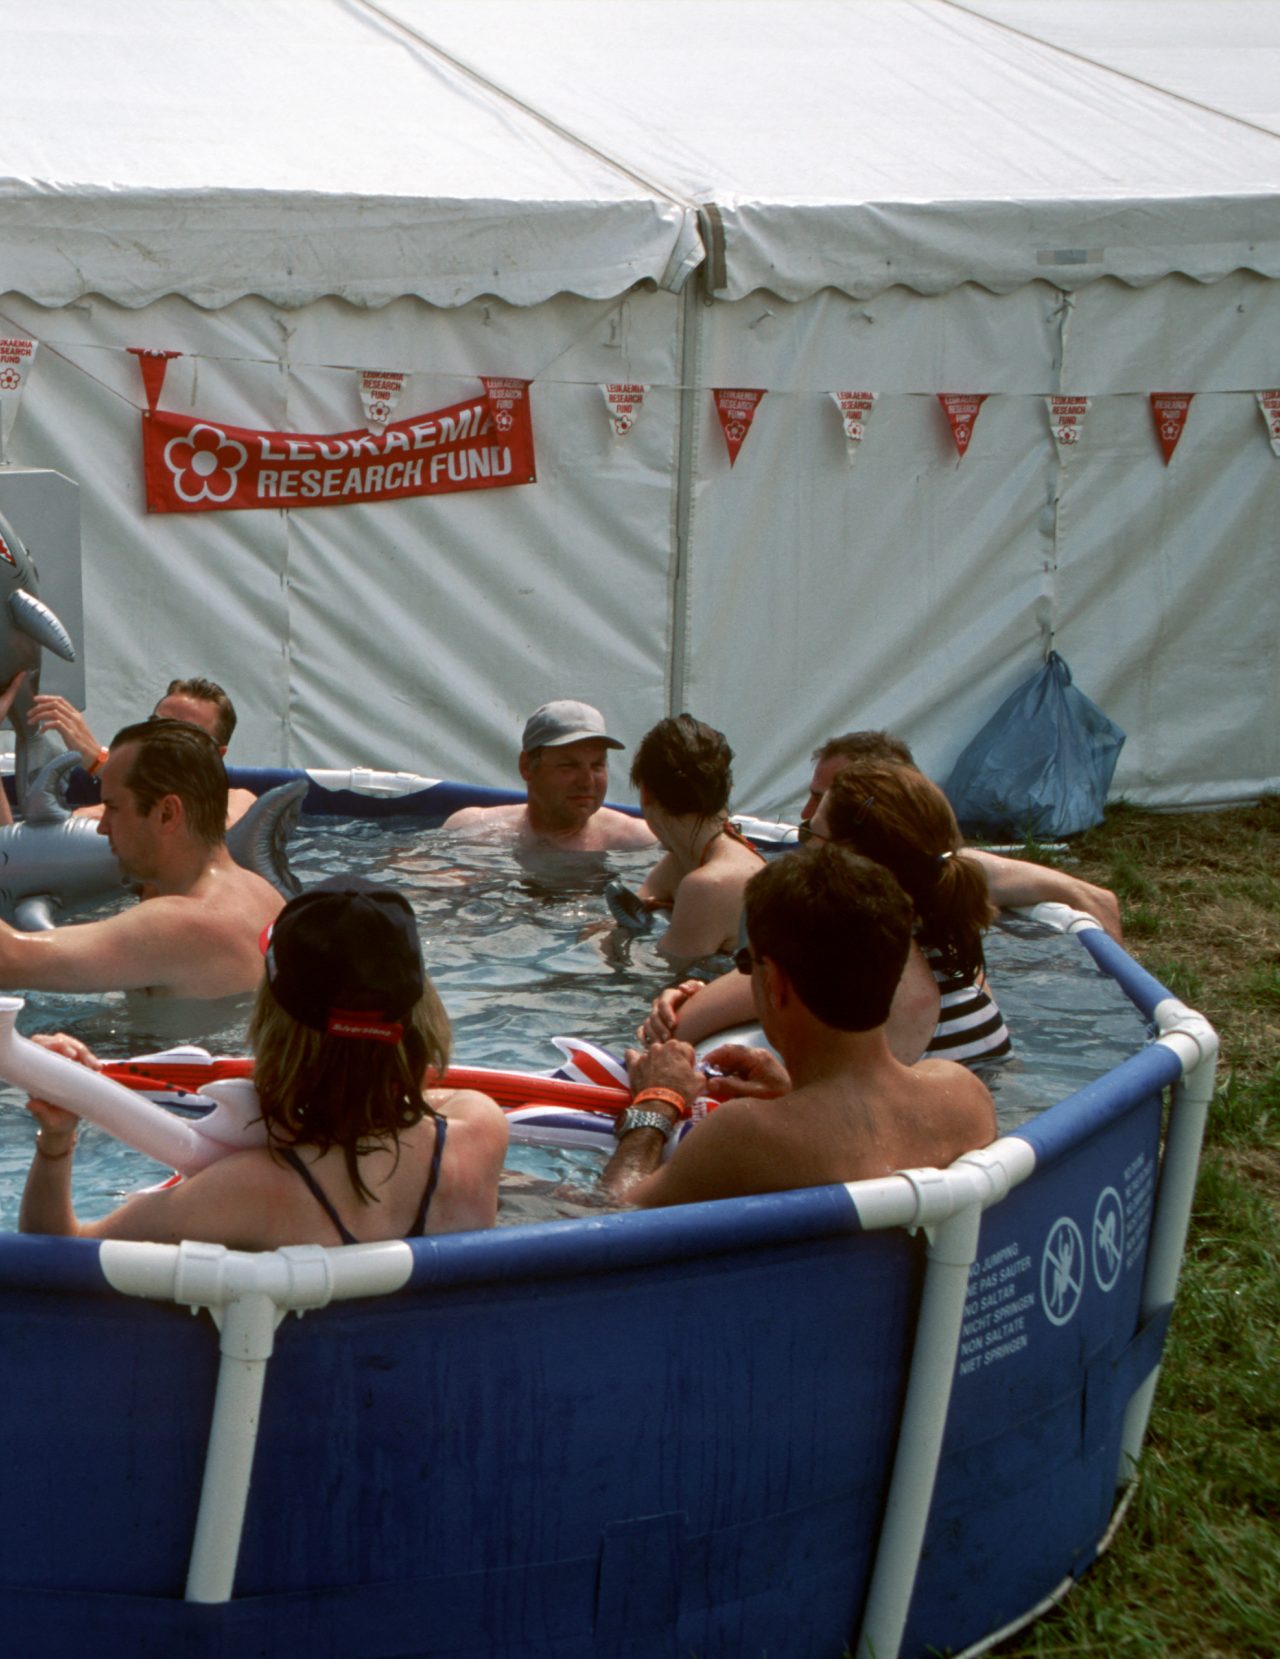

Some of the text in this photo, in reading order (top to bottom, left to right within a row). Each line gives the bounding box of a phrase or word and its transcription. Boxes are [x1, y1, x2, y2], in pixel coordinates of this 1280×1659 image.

[0, 355, 21, 364] FUND
[363, 380, 401, 391] RESEARCH
[607, 383, 645, 394] LEUKAEMIA
[371, 390, 391, 401] FUND
[489, 389, 522, 399] RESEARCH
[608, 394, 643, 403] RESEARCH
[496, 399, 513, 409] FUND
[719, 400, 753, 410] RESEARCH
[1051, 395, 1088, 405] LEUKAEMIA
[616, 404, 632, 414] FUND
[840, 401, 873, 411] RESEARCH
[1052, 405, 1086, 415] RESEARCH
[1058, 415, 1077, 425] FUND
[257, 446, 513, 498] RESEARCH FUND
[982, 1242, 1019, 1272] JUMPING
[980, 1272, 998, 1292] PAS
[1000, 1255, 1032, 1282] SAUTER
[964, 1284, 1015, 1317] NO SALTAR
[962, 1292, 1035, 1337] NICHT SPRINGEN
[961, 1316, 1025, 1356] NON SALTATE
[960, 1333, 1028, 1376] NIET SPRINGEN
